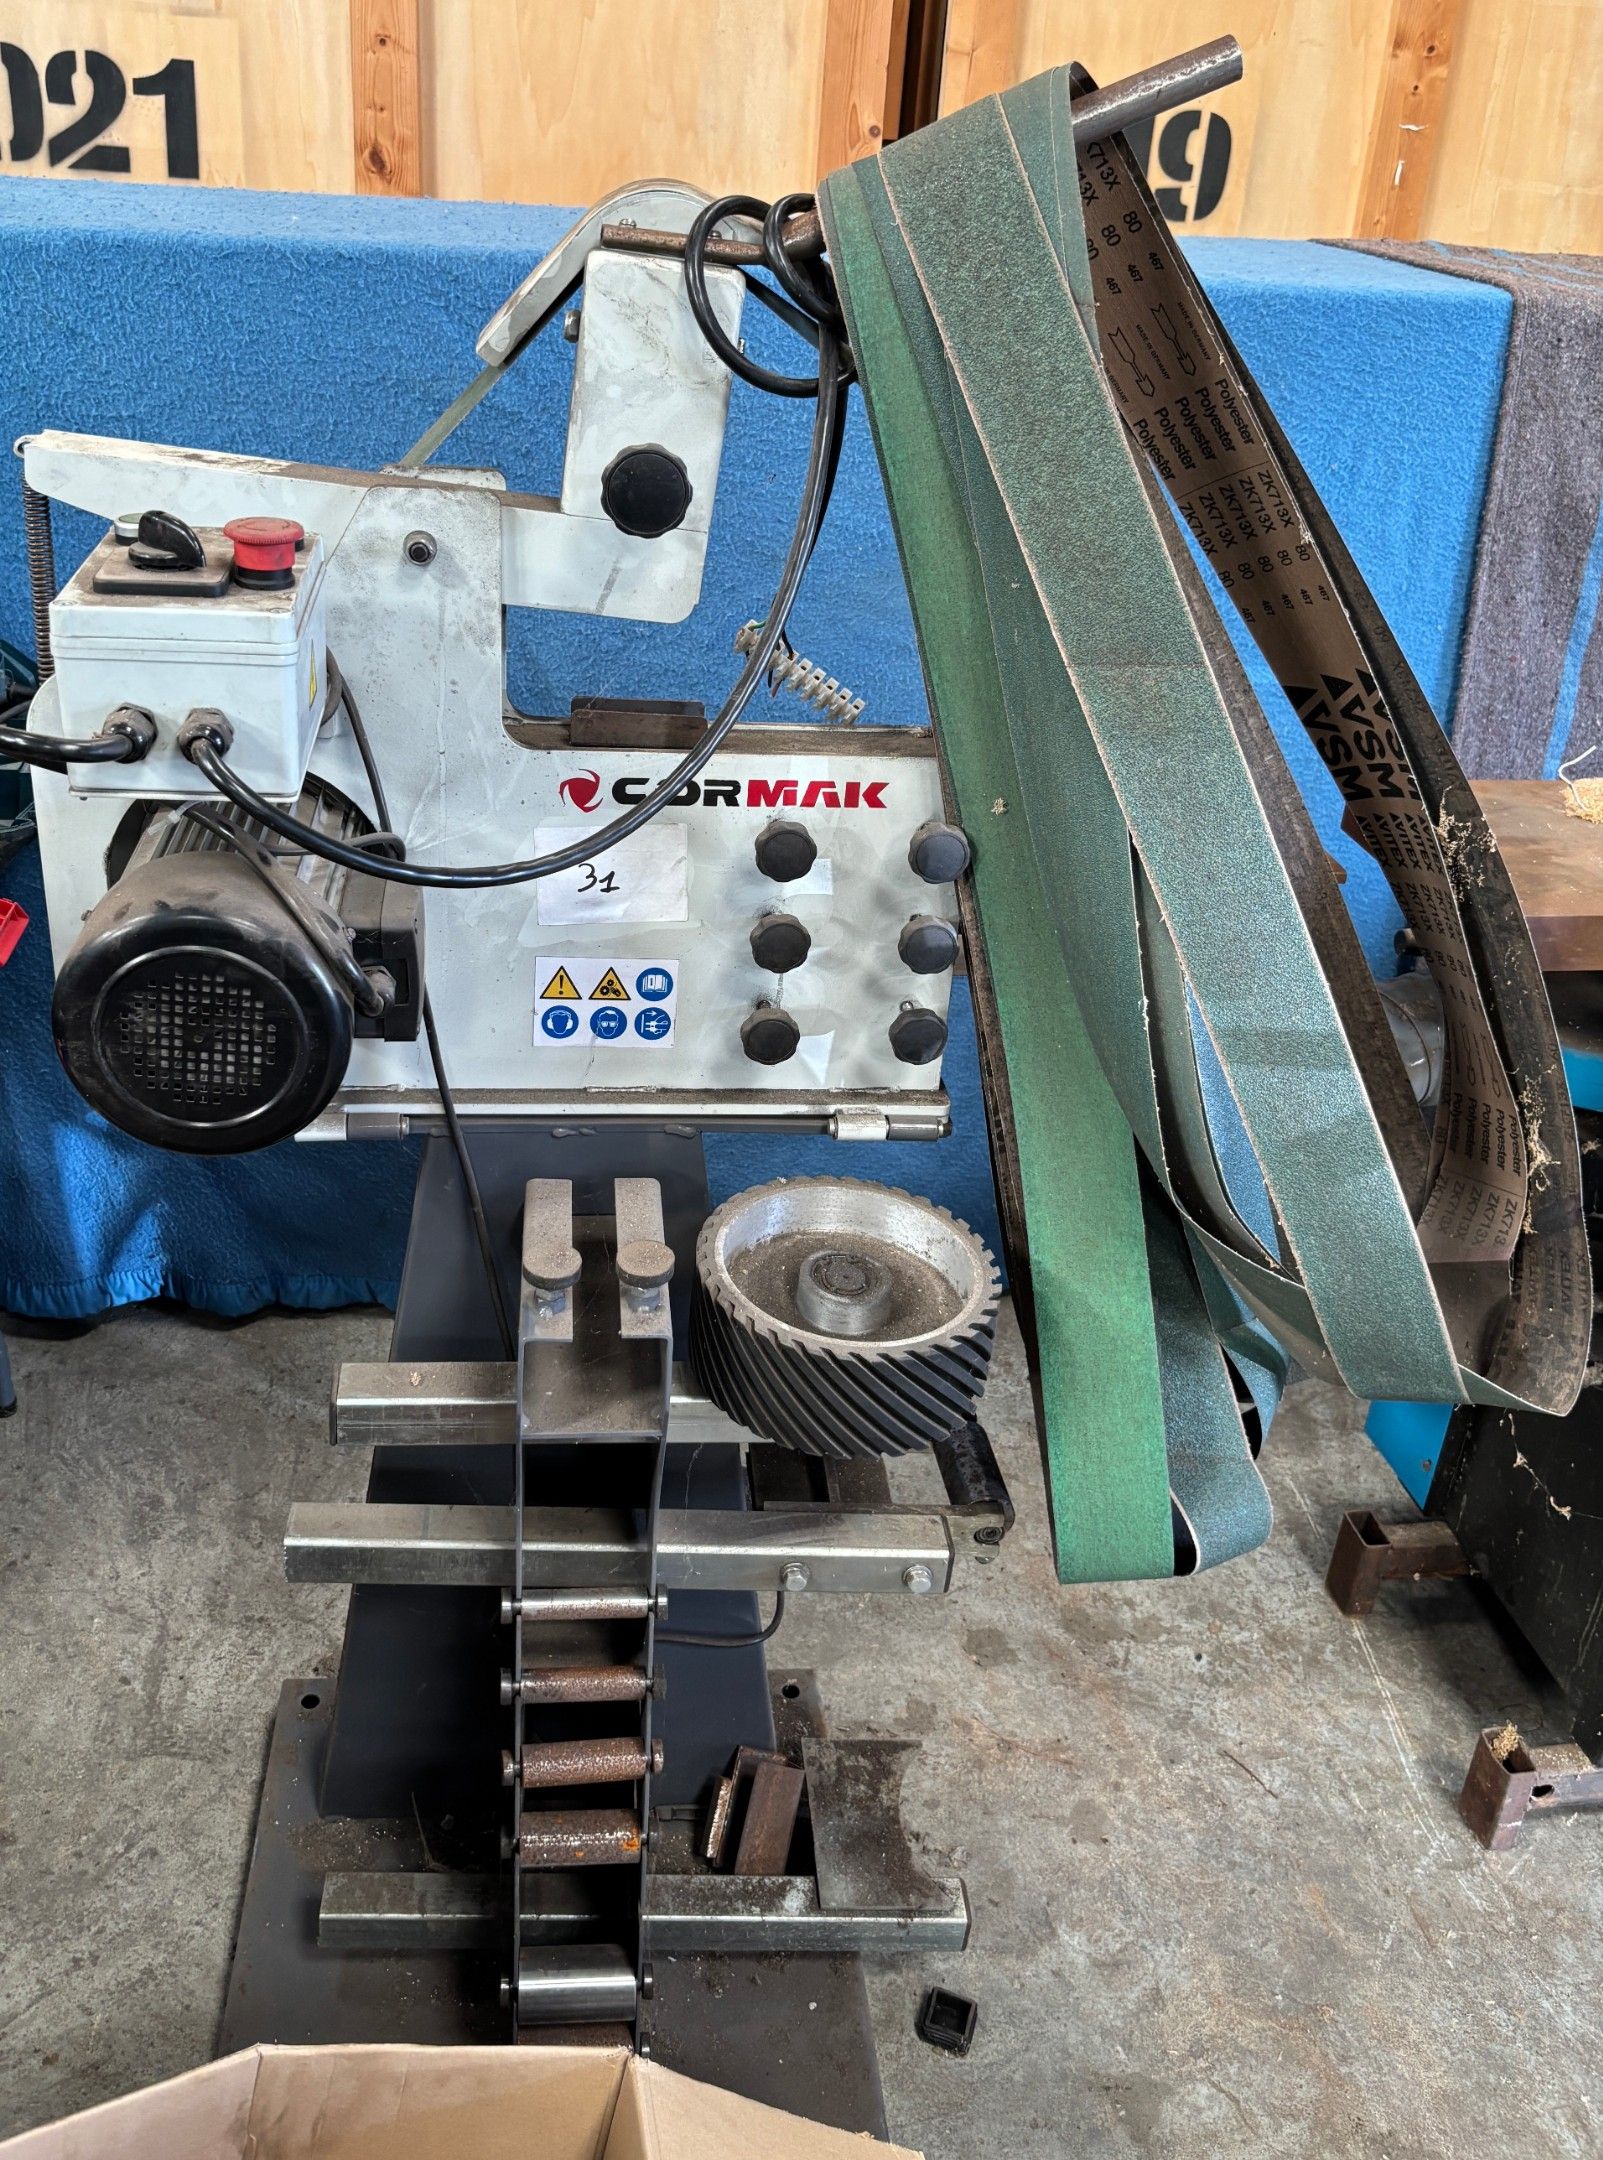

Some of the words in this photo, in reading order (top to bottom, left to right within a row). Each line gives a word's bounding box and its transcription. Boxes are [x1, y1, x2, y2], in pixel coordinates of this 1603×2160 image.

[1101, 224, 1122, 247] 80
[1127, 264, 1144, 283] 467
[1122, 211, 1143, 234] 80
[1148, 252, 1165, 271] 467
[1106, 277, 1122, 295] 467
[1133, 418, 1176, 482] Polyester
[1177, 501, 1219, 557] ZK713X
[1217, 570, 1235, 589] 80
[1153, 406, 1197, 472] Polyester
[1198, 492, 1239, 550] ZK713X
[1237, 562, 1255, 581] 80
[1261, 599, 1276, 617] 467
[1174, 396, 1217, 461] Polyester
[1218, 484, 1259, 541] ZK713X
[1257, 555, 1274, 574] 80
[1281, 593, 1295, 611] 467
[1195, 386, 1236, 453] Polyester
[1238, 476, 1277, 535] ZK713X
[1276, 550, 1293, 567] 80
[1300, 588, 1314, 606] 467
[1214, 379, 1255, 447] Polyester
[1257, 469, 1295, 529] ZK713X
[1295, 544, 1311, 562] 80
[1317, 584, 1330, 602] 467
[612, 777, 890, 808] CORMAK
[577, 863, 620, 893] 31
[1480, 1103, 1492, 1166] Polyester
[1495, 1108, 1507, 1171] Polyester
[1509, 1115, 1521, 1177] Polyester
